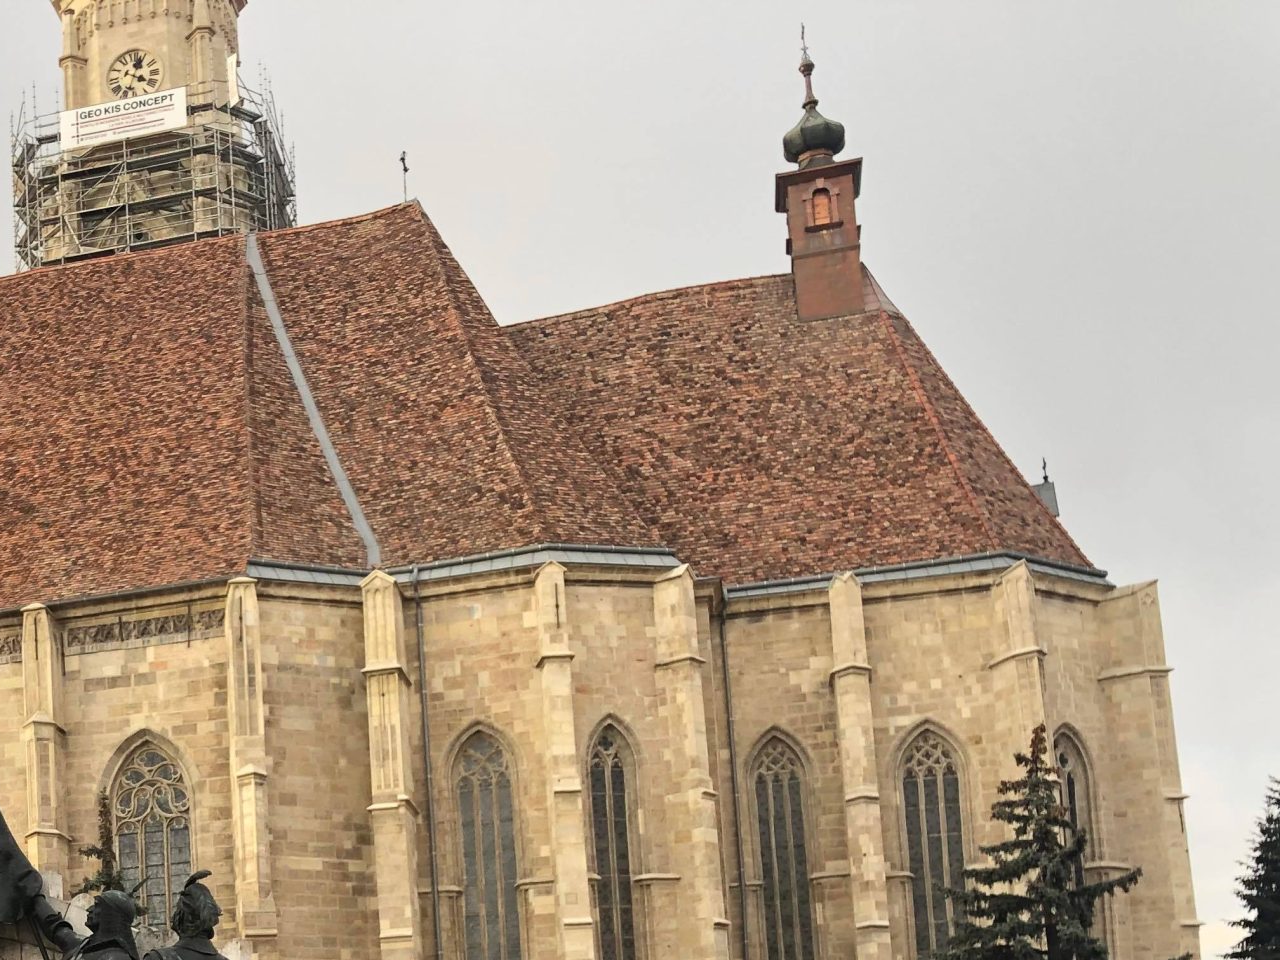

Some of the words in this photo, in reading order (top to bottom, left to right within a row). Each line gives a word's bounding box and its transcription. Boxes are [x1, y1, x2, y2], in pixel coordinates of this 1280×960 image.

[80, 108, 102, 120] GEO
[104, 103, 121, 116] KIS
[123, 93, 175, 111] CONCEPT
